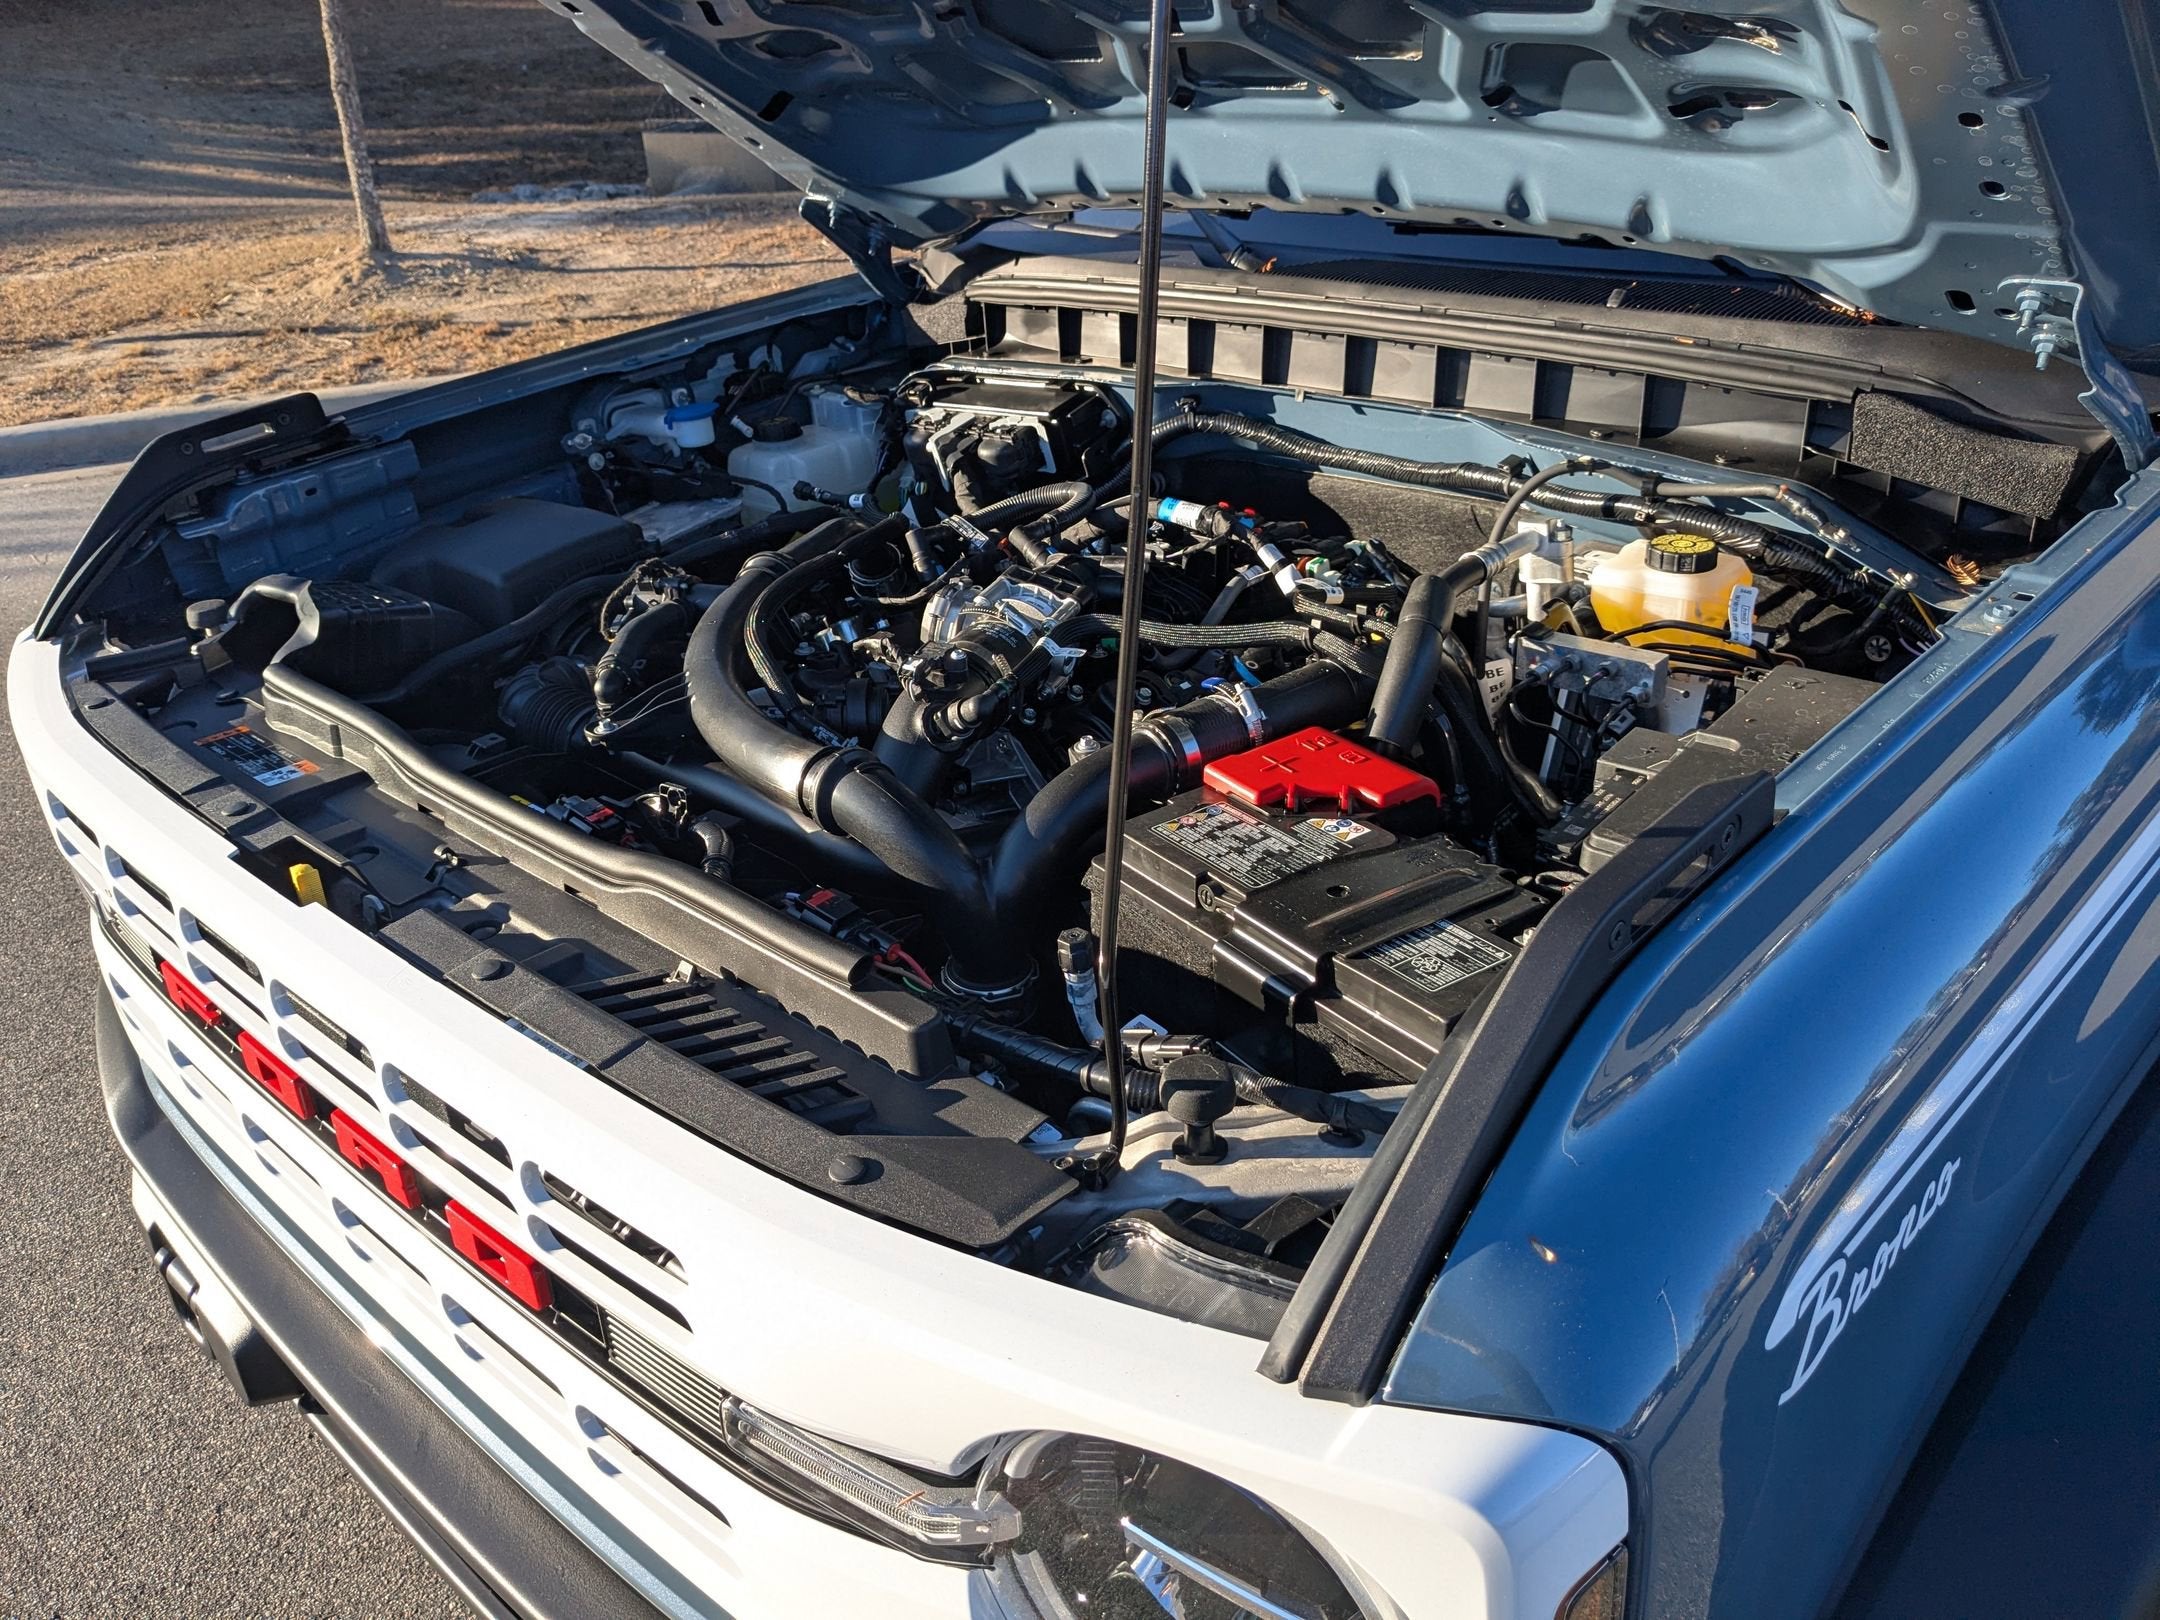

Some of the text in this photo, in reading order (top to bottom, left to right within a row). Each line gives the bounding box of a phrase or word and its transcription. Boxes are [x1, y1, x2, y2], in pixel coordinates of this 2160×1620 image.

[1485, 667, 1505, 679] BE
[160, 960, 553, 1311] FORD
[1778, 1157, 1961, 1406] Bronco
